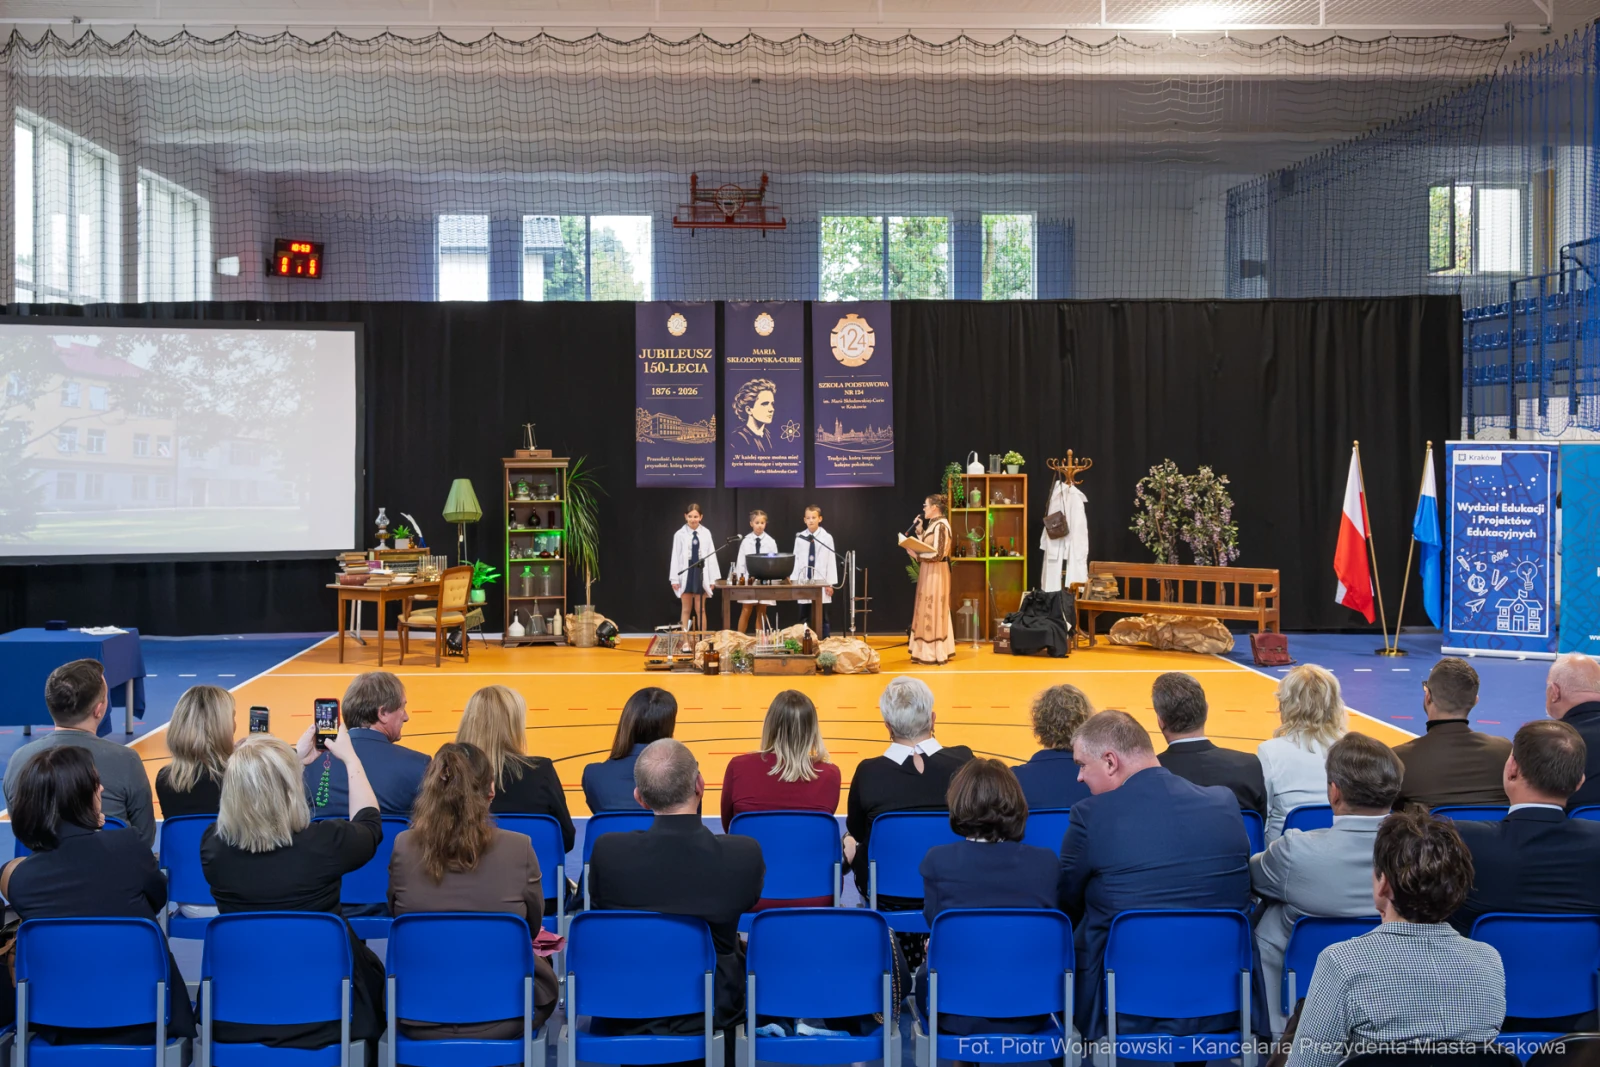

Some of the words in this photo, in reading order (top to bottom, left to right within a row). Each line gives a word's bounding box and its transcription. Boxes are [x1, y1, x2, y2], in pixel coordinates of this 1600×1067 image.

[292, 244, 310, 253] 10:53
[840, 328, 866, 350] 124
[638, 348, 712, 359] JUBILEUSZ
[644, 362, 709, 373] 150-LECIA
[1457, 502, 1499, 514] Wydział
[1502, 503, 1545, 515] Edukacji
[1472, 515, 1476, 524] i
[1478, 515, 1532, 527] Projektów
[1467, 527, 1537, 540] Edukacyjnych
